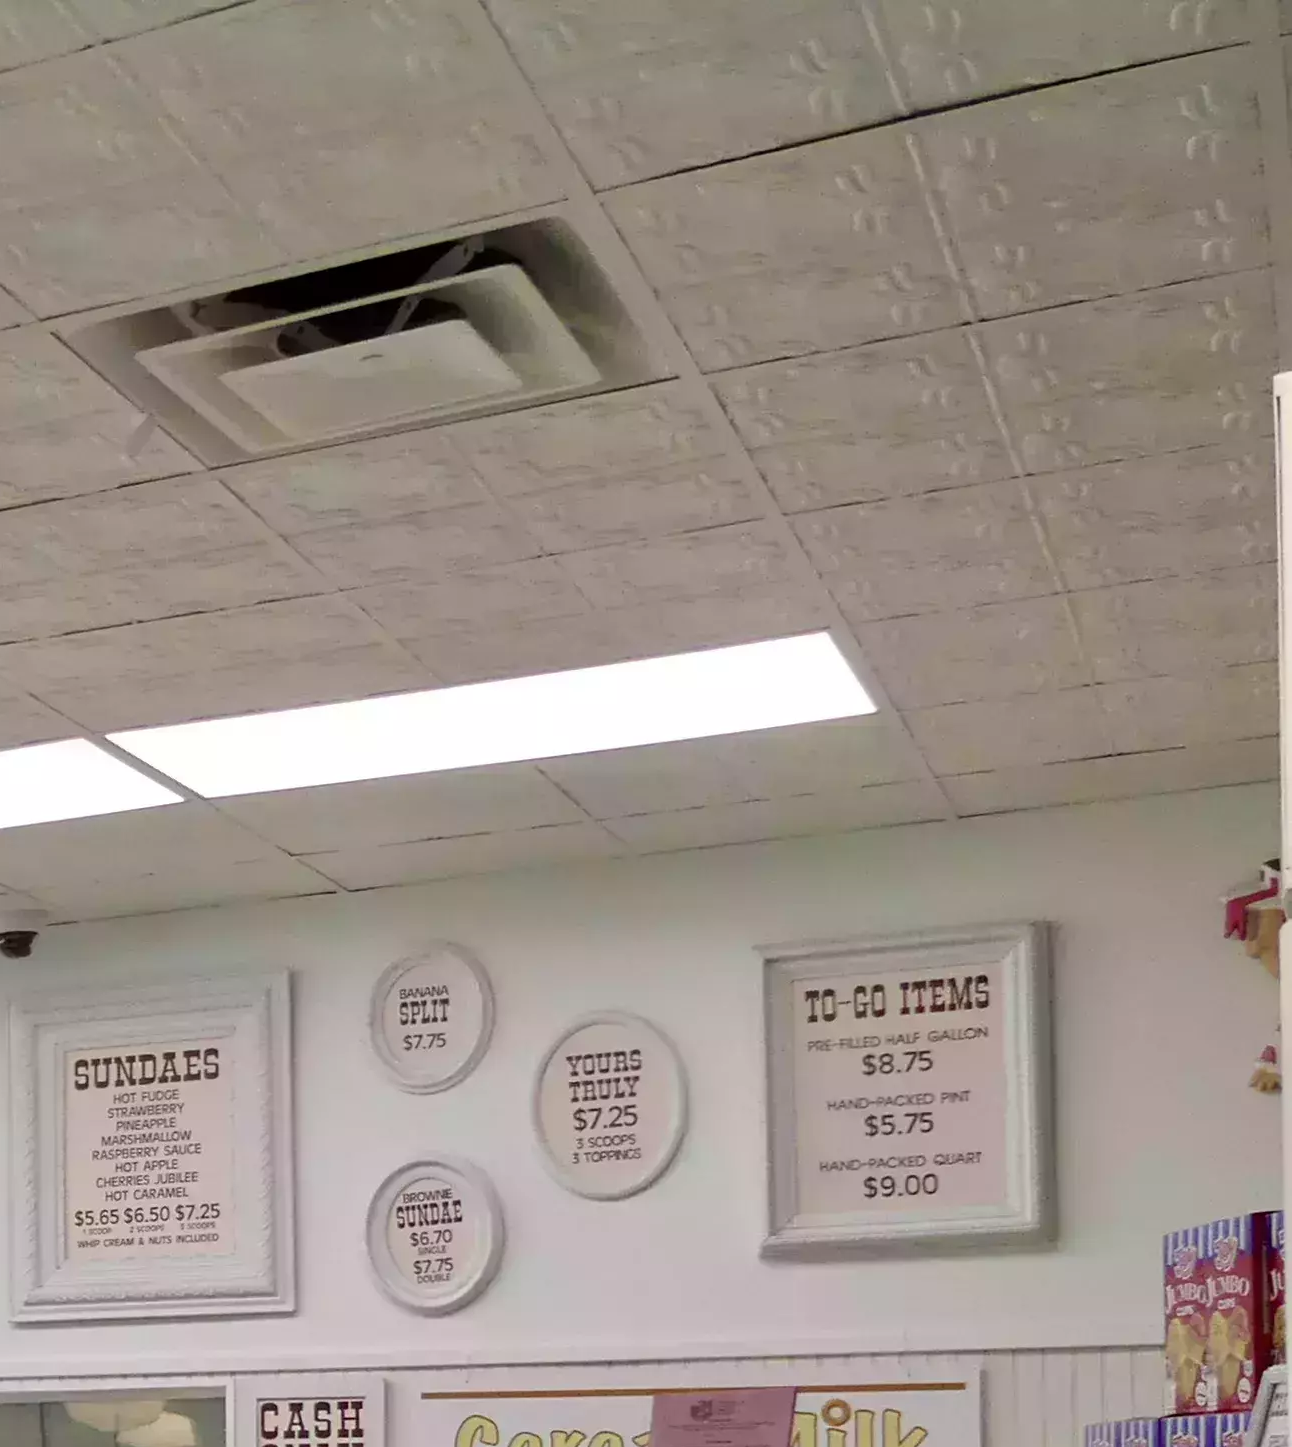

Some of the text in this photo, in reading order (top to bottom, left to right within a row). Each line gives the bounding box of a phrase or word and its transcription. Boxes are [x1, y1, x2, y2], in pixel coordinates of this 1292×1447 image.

[399, 985, 449, 1000] BANANA
[804, 974, 990, 1023] TO-GO ITEMS
[399, 999, 450, 1026] SPLIT
[403, 1033, 446, 1051] $7.75
[807, 1027, 989, 1052] PRE-FILLED HALF GALLON
[74, 1048, 219, 1091] SUNDAES
[566, 1049, 642, 1077] YOURS
[862, 1050, 934, 1076] $8.75
[113, 1088, 180, 1105] HOT FUDGE
[569, 1076, 640, 1102] TRULY
[826, 1090, 971, 1111] HAND-PACKED PINT
[107, 1103, 185, 1119] STRAWBERRY
[573, 1105, 638, 1132] $7.25
[116, 1117, 177, 1132] PINEAPPLE
[864, 1112, 934, 1138] $5.75
[101, 1130, 192, 1147] MARSHMALLOW
[576, 1134, 635, 1149] 3 SCOOPS
[92, 1143, 201, 1162] RASPBERRY SAUCE
[584, 1148, 641, 1163] TOPPINGS
[819, 1151, 982, 1172] HAND-PACKED QUART
[115, 1159, 179, 1173] HOT APPLE
[96, 1171, 198, 1189] CHERRIES JUBILEE
[863, 1173, 939, 1199] $9.00
[104, 1187, 189, 1202] HOT CARAMEL
[403, 1188, 453, 1204] BROWNIE
[74, 1203, 220, 1227] $5.65 $6.50 $7.25
[396, 1199, 463, 1229] SUNDAE
[409, 1229, 453, 1247] $6.70
[413, 1257, 454, 1275] $7.75
[417, 1273, 451, 1284] DOUBLE
[260, 1400, 364, 1440] CASH
